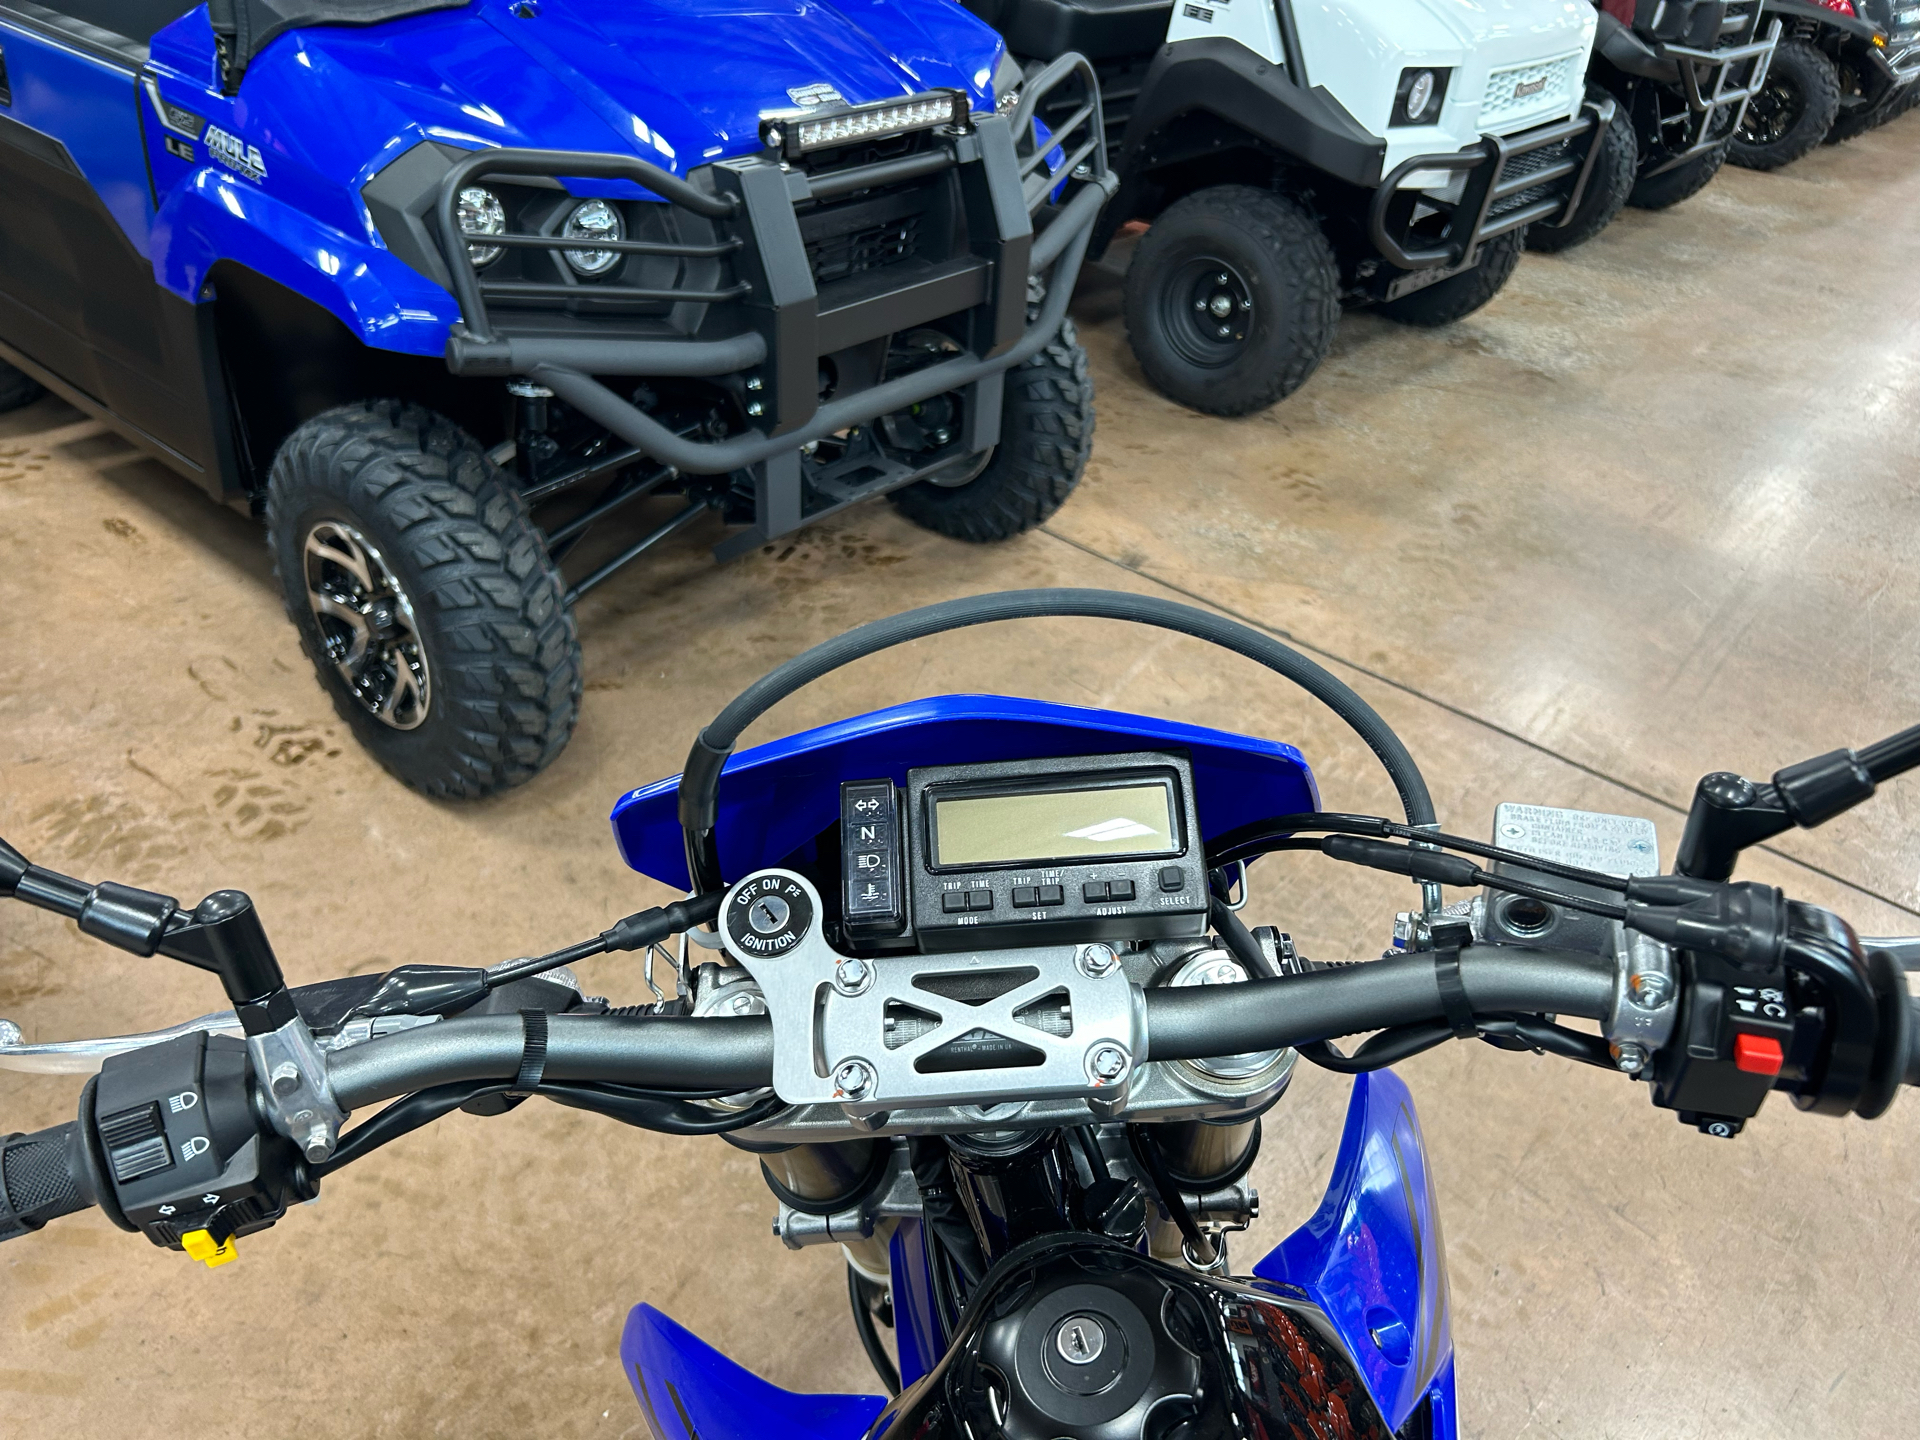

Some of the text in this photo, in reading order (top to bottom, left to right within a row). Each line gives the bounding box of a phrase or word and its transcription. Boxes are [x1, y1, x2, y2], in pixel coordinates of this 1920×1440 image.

[165, 136, 195, 162] LE
[204, 124, 268, 178] MULE
[1504, 804, 1564, 818] WARNING
[1510, 814, 1540, 823] BRAKE
[861, 826, 875, 840] N
[1041, 869, 1065, 878] TIME/
[944, 880, 990, 890] TRIP TIME
[1013, 877, 1031, 885] TRIP
[1042, 878, 1060, 886] TRIP
[737, 883, 757, 905] OFF
[762, 879, 780, 890] ON
[1160, 896, 1191, 906] SELECT
[1032, 912, 1047, 920] SET
[1096, 906, 1127, 916] ADJUST
[957, 916, 979, 925] MODE
[741, 930, 796, 951] IGNITION
